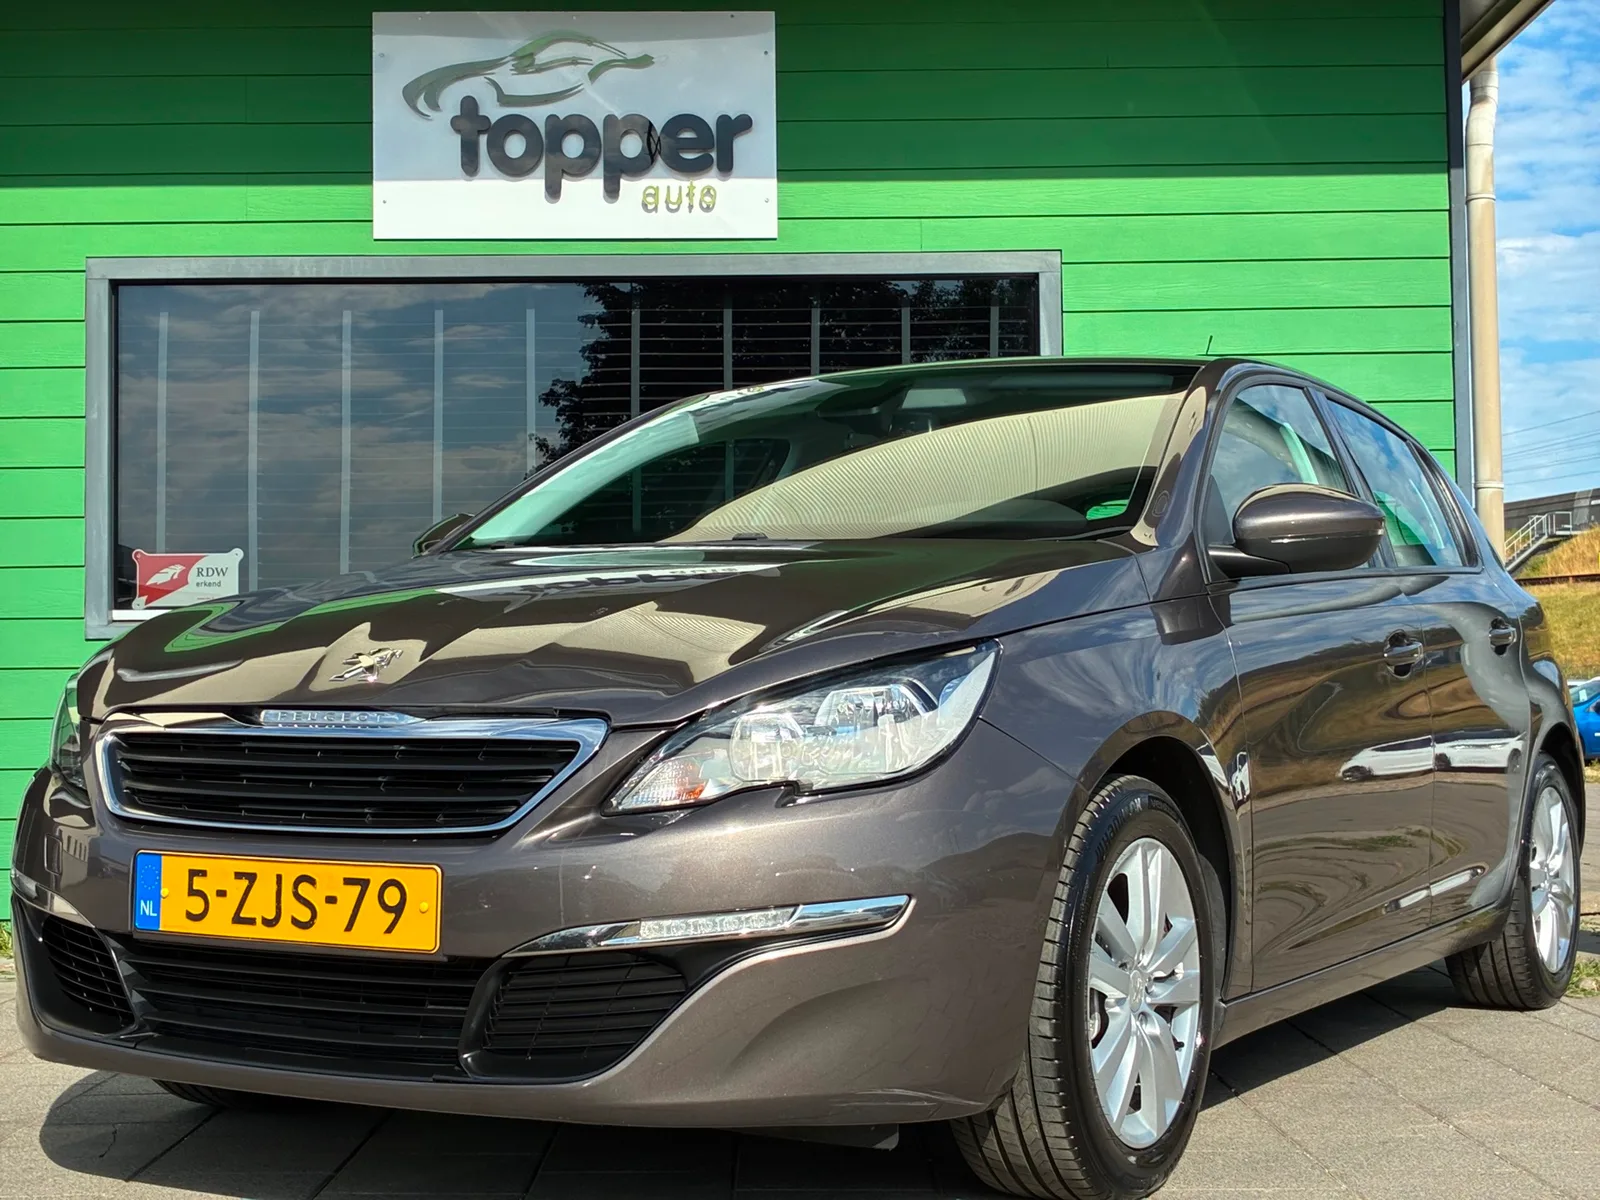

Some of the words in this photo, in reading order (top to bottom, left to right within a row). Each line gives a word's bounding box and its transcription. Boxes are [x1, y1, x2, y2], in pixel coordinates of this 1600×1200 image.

[449, 95, 754, 203] topper
[641, 181, 718, 212] auto
[196, 567, 229, 578] RDW
[195, 580, 222, 588] erkend
[277, 710, 387, 723] PEUGEOT
[139, 900, 158, 917] NL
[184, 868, 408, 935] 5-ZJS-79
